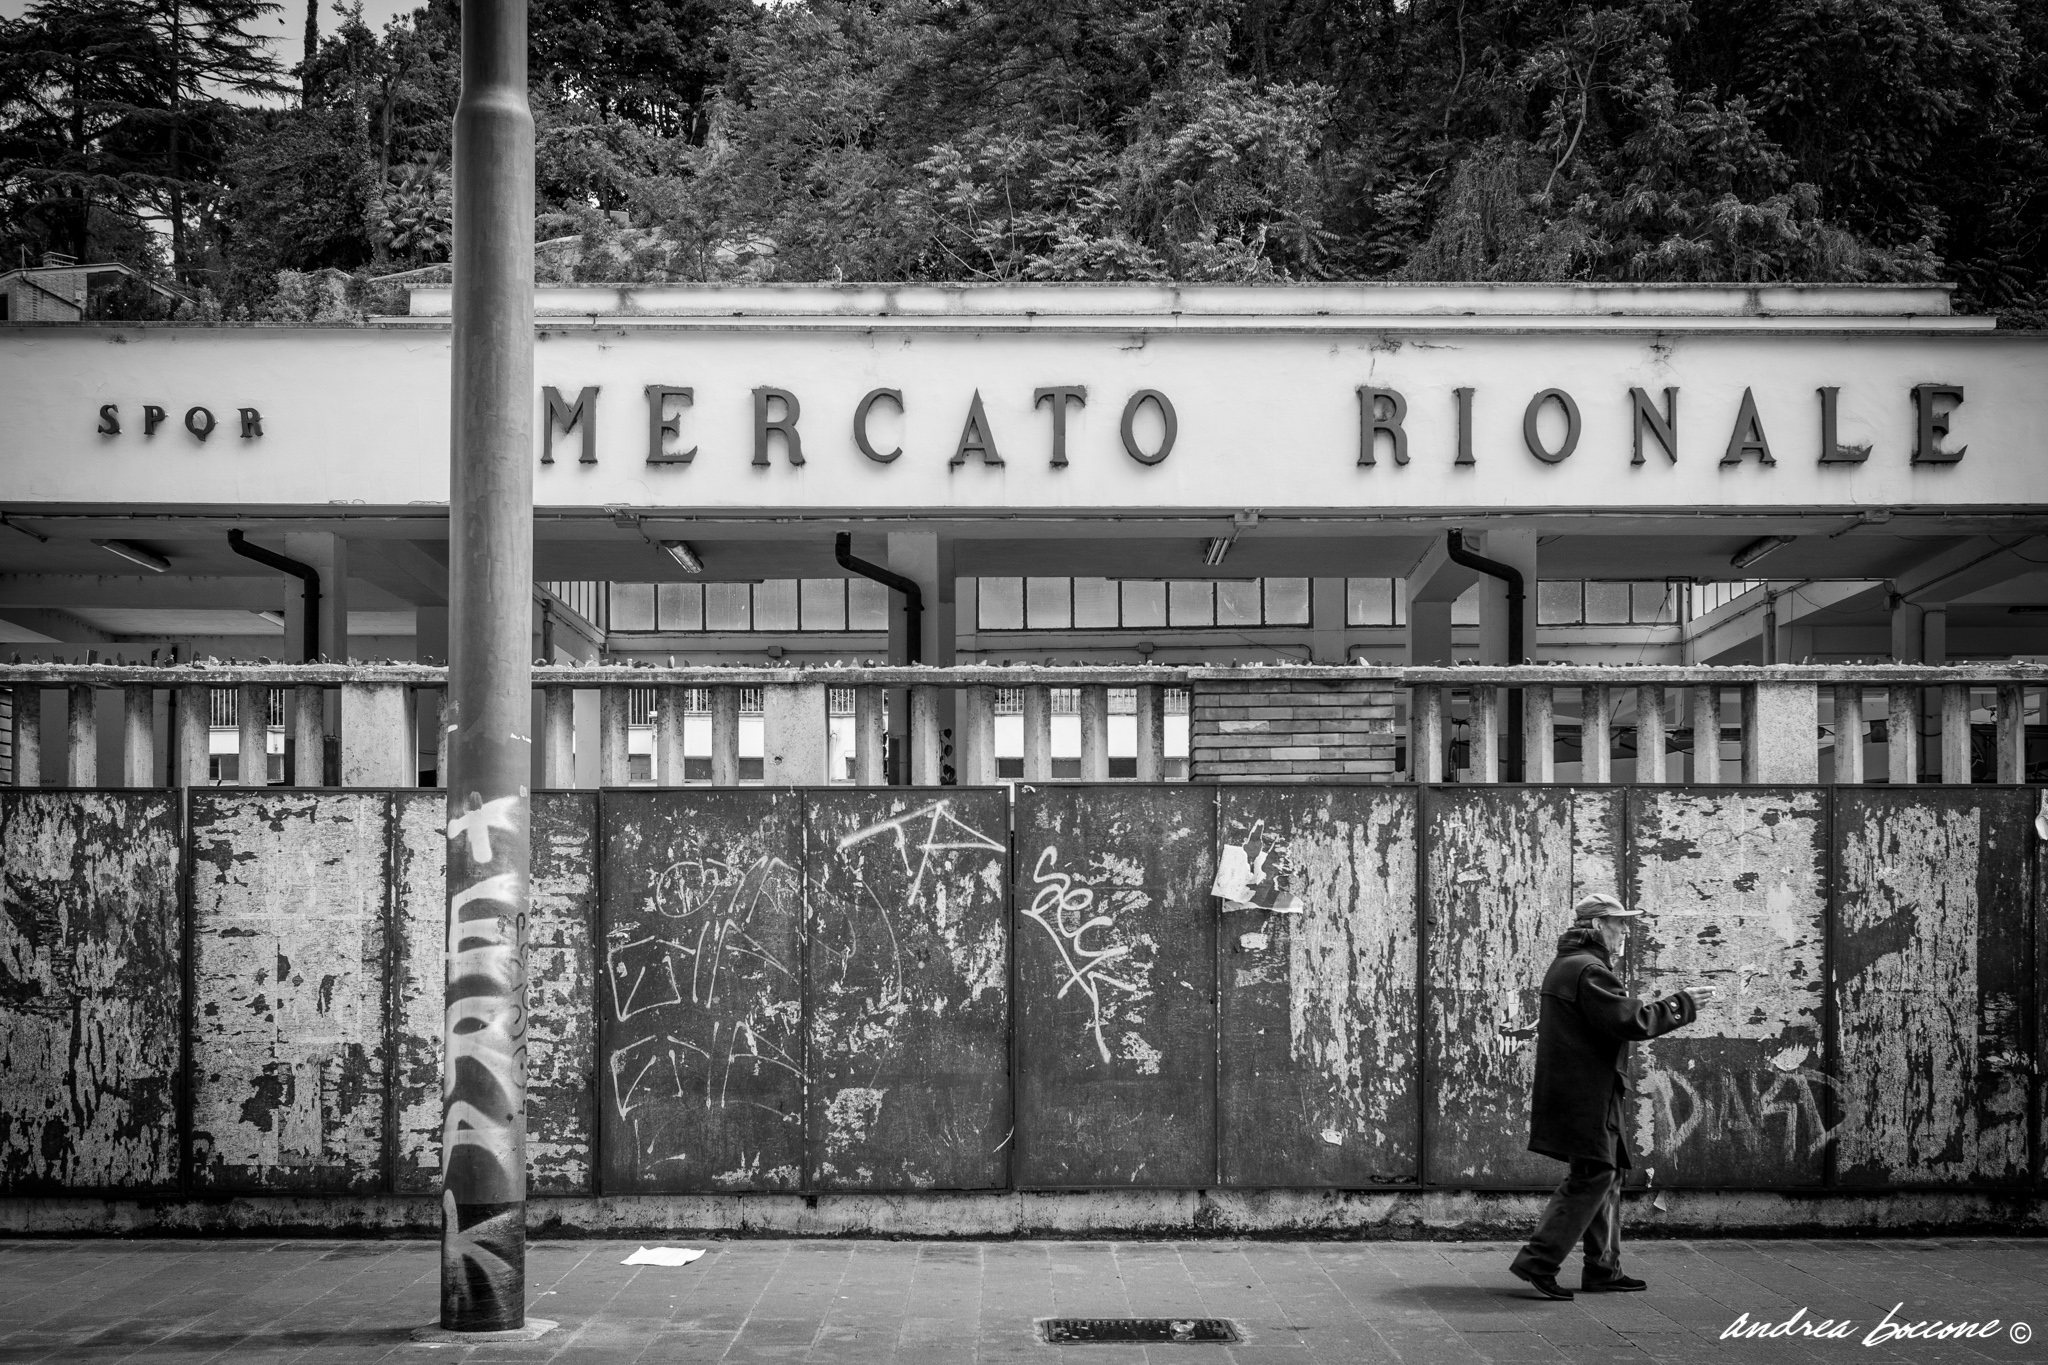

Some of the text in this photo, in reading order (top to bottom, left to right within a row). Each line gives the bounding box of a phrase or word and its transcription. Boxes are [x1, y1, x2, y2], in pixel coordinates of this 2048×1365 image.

[97, 403, 264, 443] SPQR
[541, 383, 1968, 467] MERCATO RIONALE
